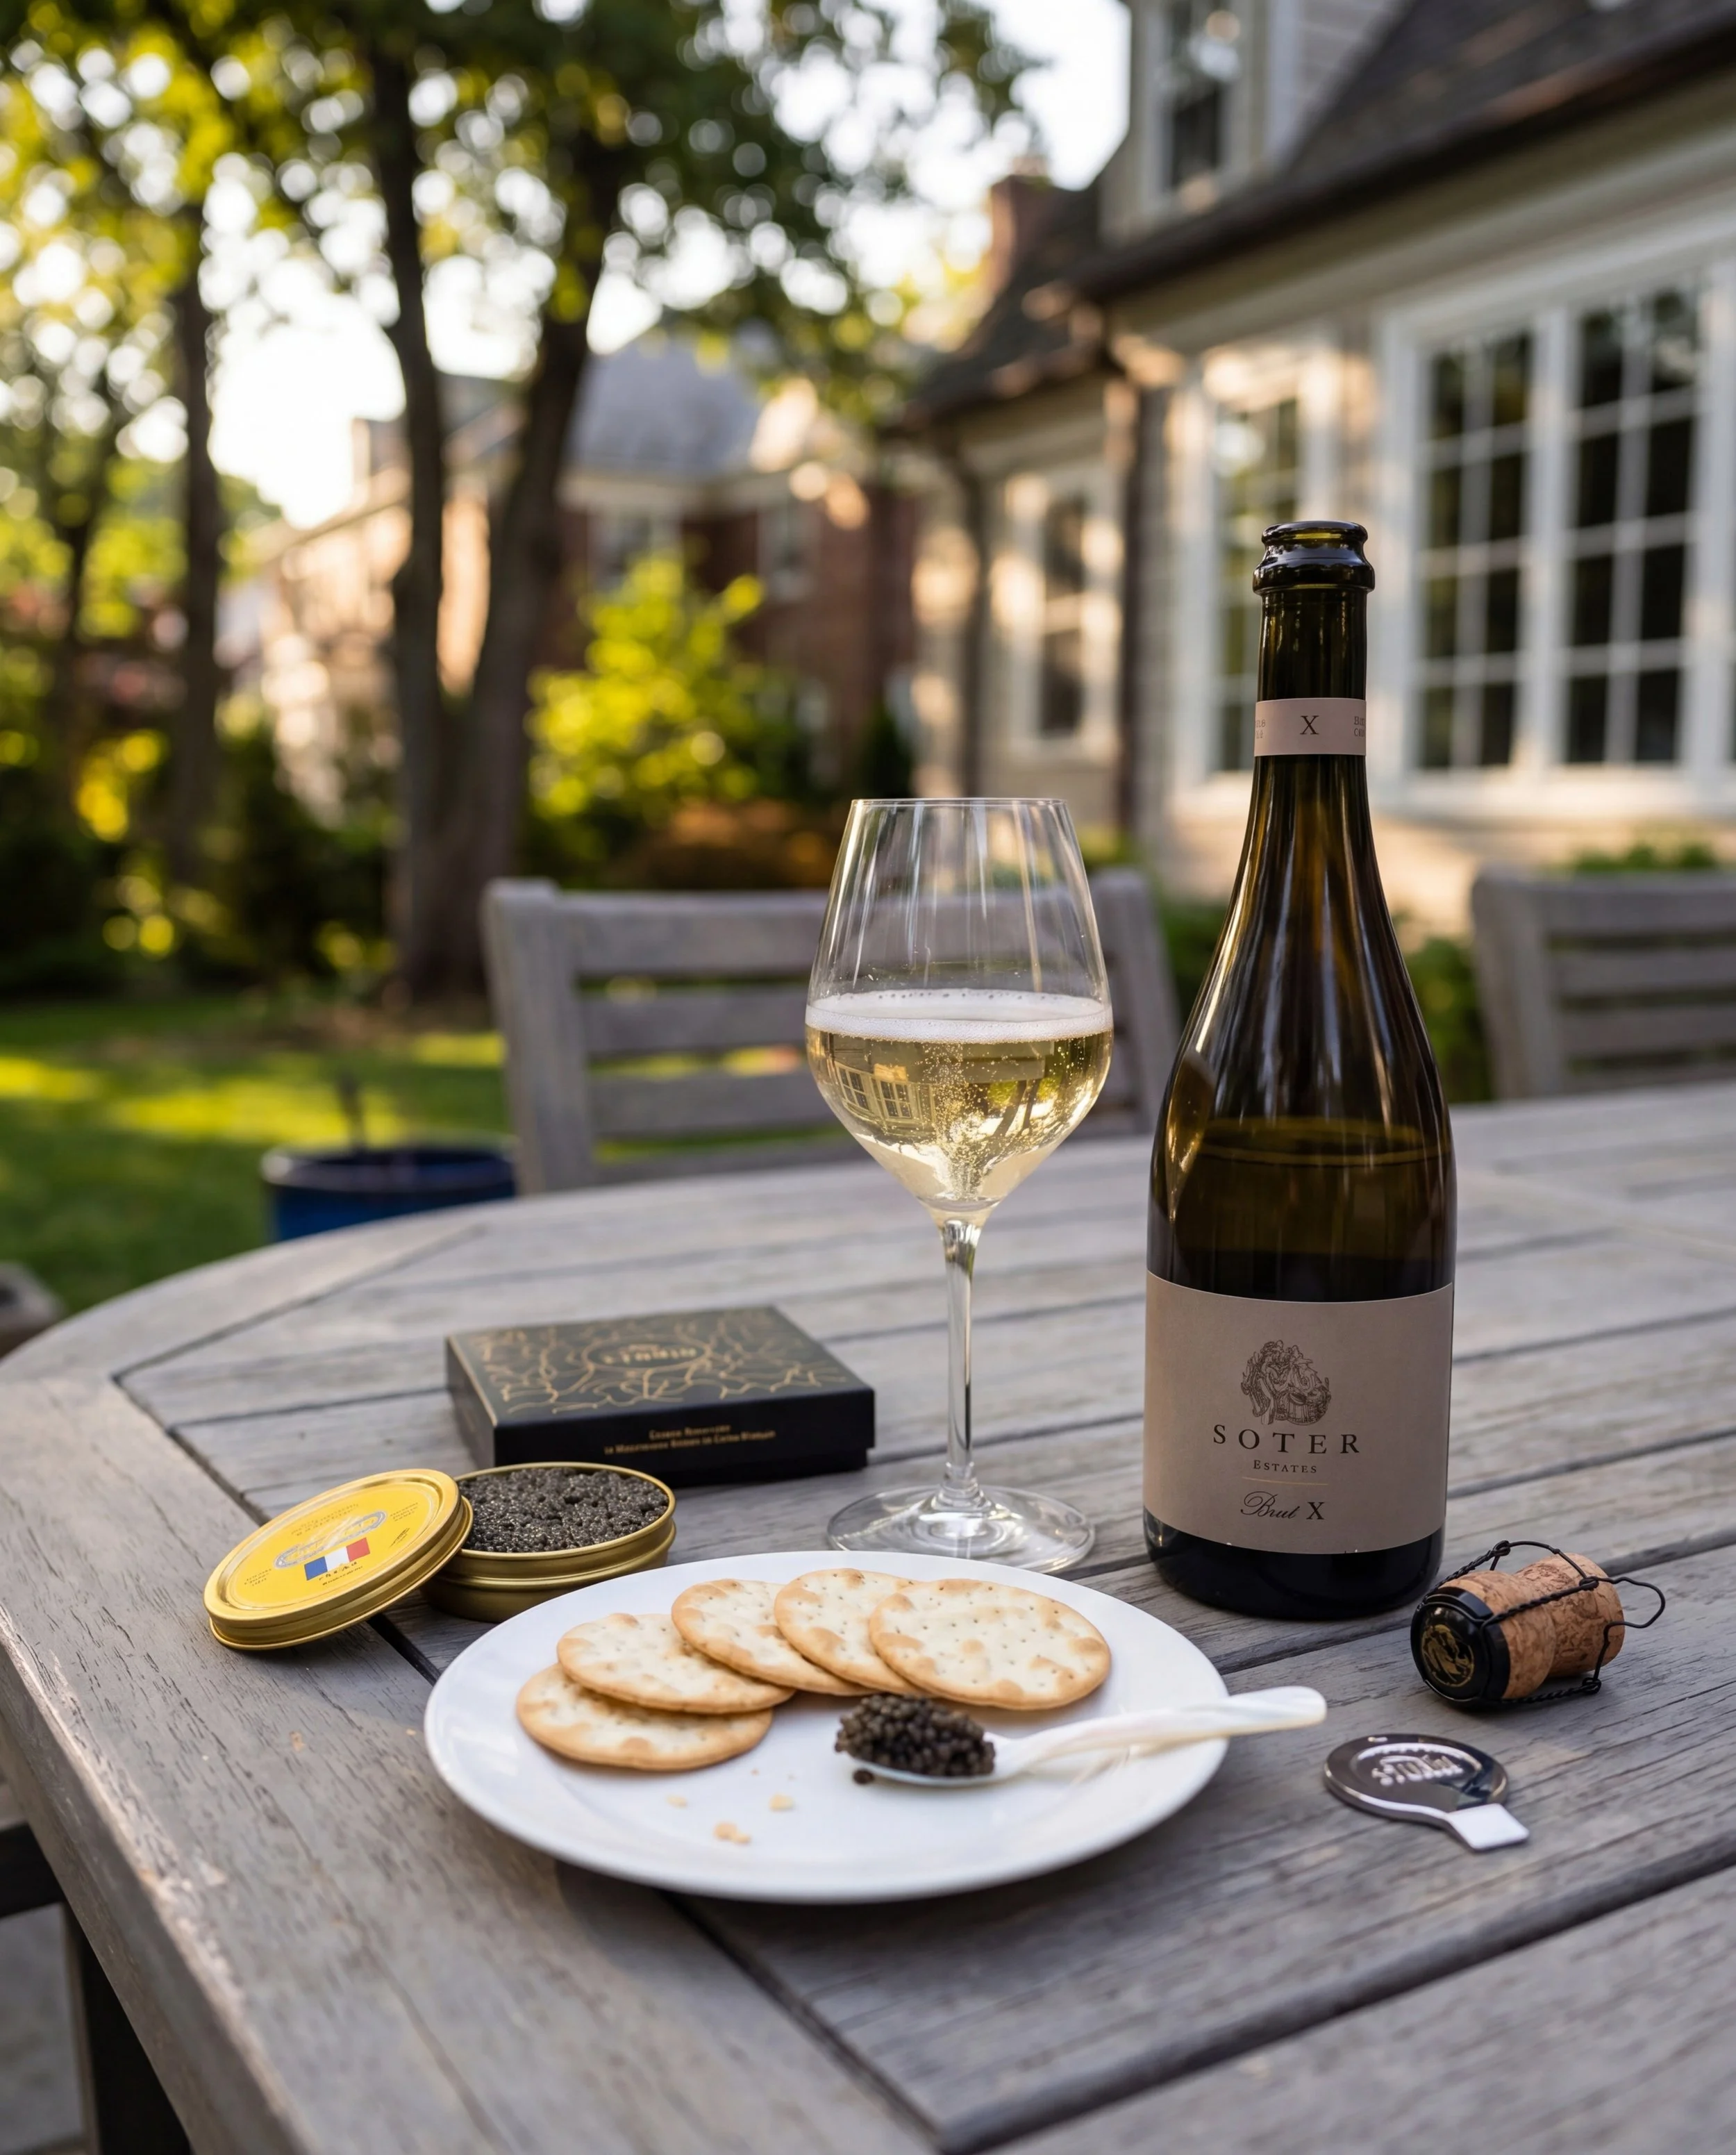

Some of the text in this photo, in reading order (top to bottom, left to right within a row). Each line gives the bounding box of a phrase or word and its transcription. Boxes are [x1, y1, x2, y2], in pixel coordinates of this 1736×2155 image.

[1300, 715, 1319, 735] X
[1213, 1424, 1360, 1454] SOTER
[1253, 1459, 1317, 1474] ESTATES
[1240, 1490, 1325, 1520] Brut X
